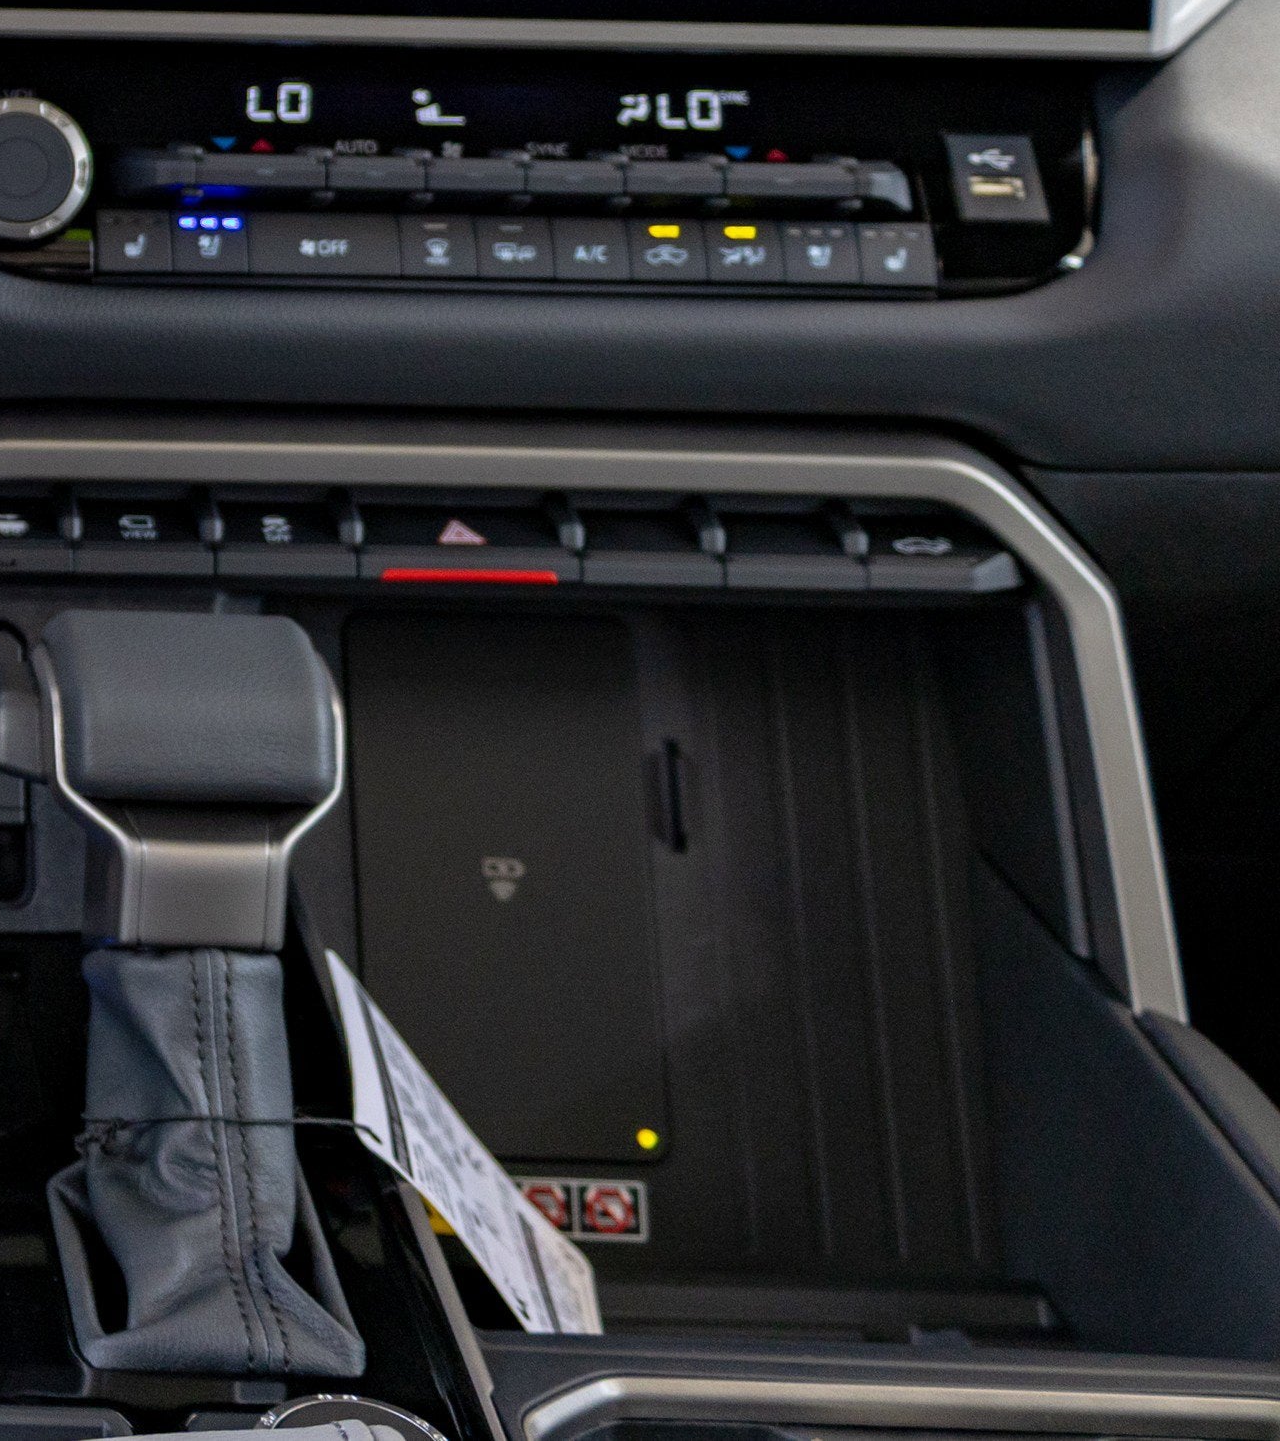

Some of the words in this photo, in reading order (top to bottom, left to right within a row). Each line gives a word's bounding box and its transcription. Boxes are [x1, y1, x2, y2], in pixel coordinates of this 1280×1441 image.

[246, 82, 312, 123] LO
[335, 139, 378, 154] AUTO
[316, 239, 349, 256] OFF
[573, 244, 608, 263] A/C
[121, 529, 158, 541] VIEW
